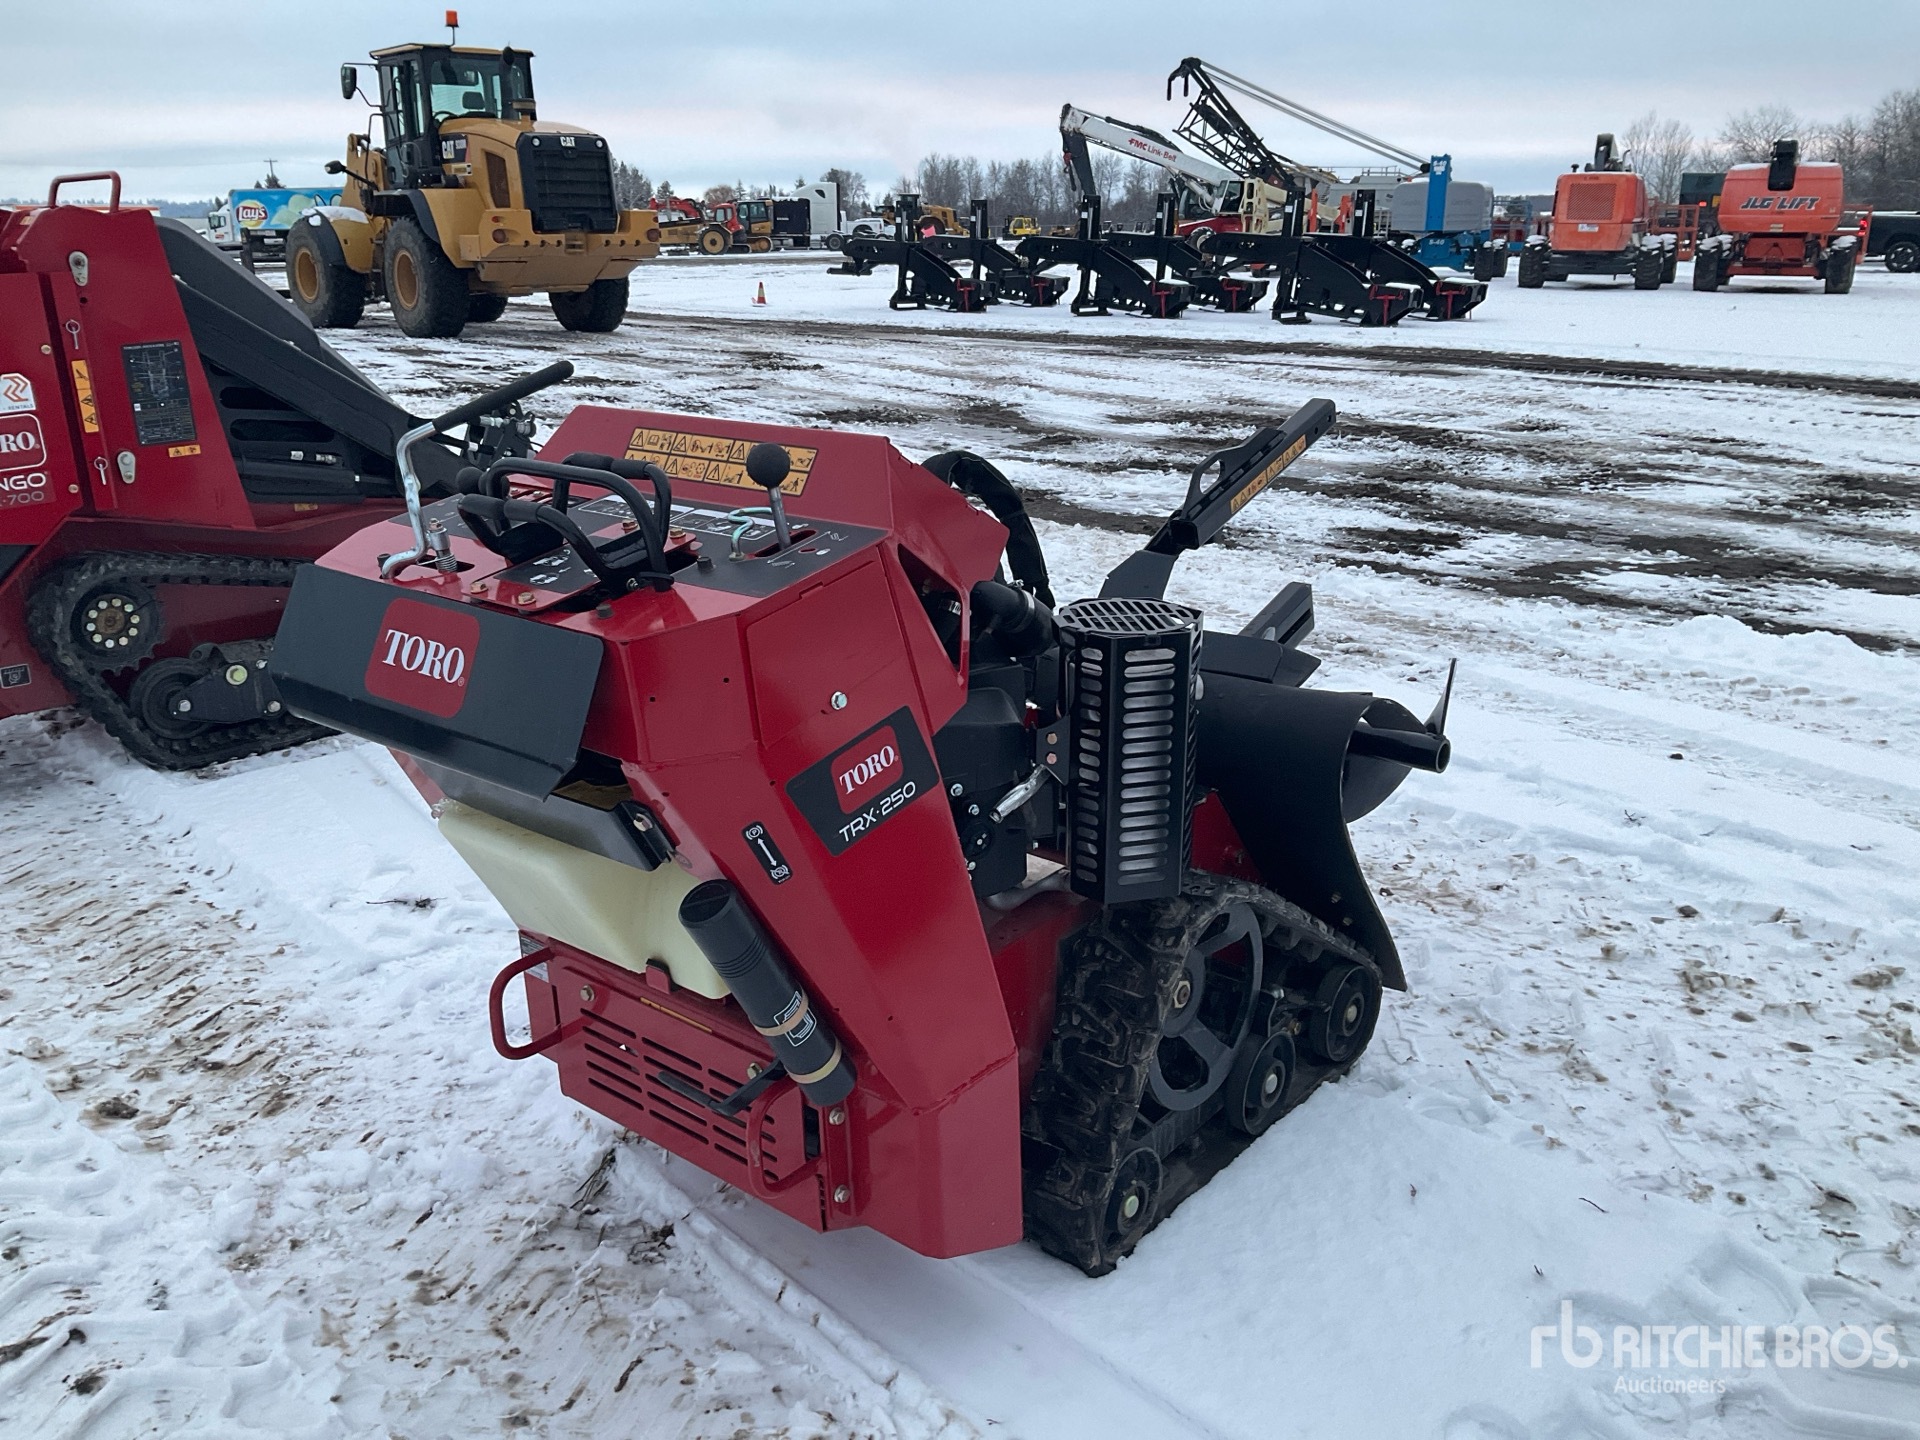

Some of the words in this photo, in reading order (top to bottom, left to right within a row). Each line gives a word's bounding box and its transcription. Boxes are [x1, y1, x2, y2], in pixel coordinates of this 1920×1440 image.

[560, 136, 576, 147] CAT
[1128, 138, 1148, 151] FMC
[441, 141, 455, 159] CAT
[1739, 197, 1776, 210] JLG
[1776, 196, 1821, 210] LIFT
[382, 629, 465, 684] TORO
[839, 745, 895, 795] TORO
